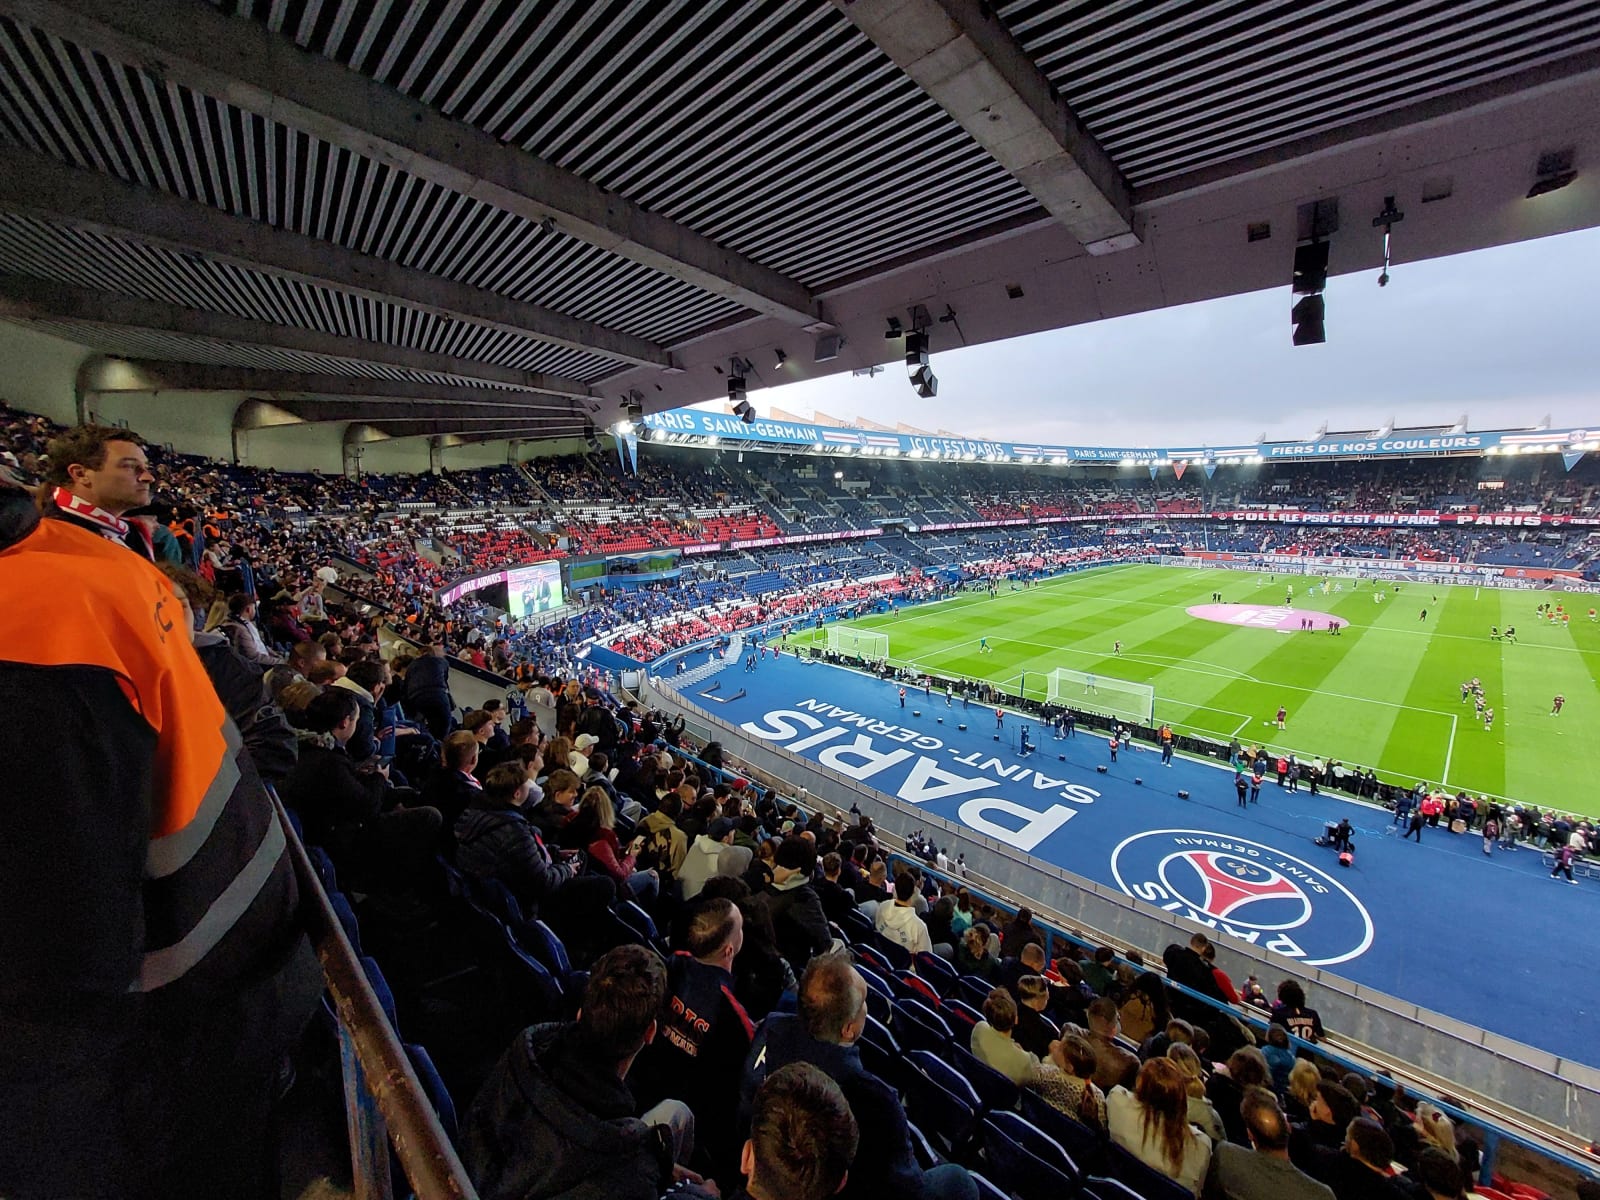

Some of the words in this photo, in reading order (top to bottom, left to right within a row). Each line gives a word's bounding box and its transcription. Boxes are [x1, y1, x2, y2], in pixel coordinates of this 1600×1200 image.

[702, 416, 818, 441] SAINT-GERMAIN
[910, 437, 930, 452] ICI
[931, 438, 966, 455] C'EST
[968, 441, 1005, 456] PARIS
[1272, 445, 1314, 456] FIERS
[1318, 444, 1340, 453] DE
[1342, 442, 1378, 452] NOS
[1382, 436, 1481, 451] COULEURS
[1074, 449, 1097, 458] PARIS
[1098, 450, 1159, 459] SAINT-GERMAIN
[1285, 513, 1300, 523] LE
[1302, 513, 1331, 523] PSG
[1332, 514, 1371, 524] C'EST
[1374, 514, 1395, 524] AU
[1398, 515, 1440, 525] PARC
[1457, 515, 1542, 526] PARIS
[1563, 585, 1600, 594] QATAR
[740, 709, 1079, 852] PARIS
[1291, 1025, 1313, 1040] 10
